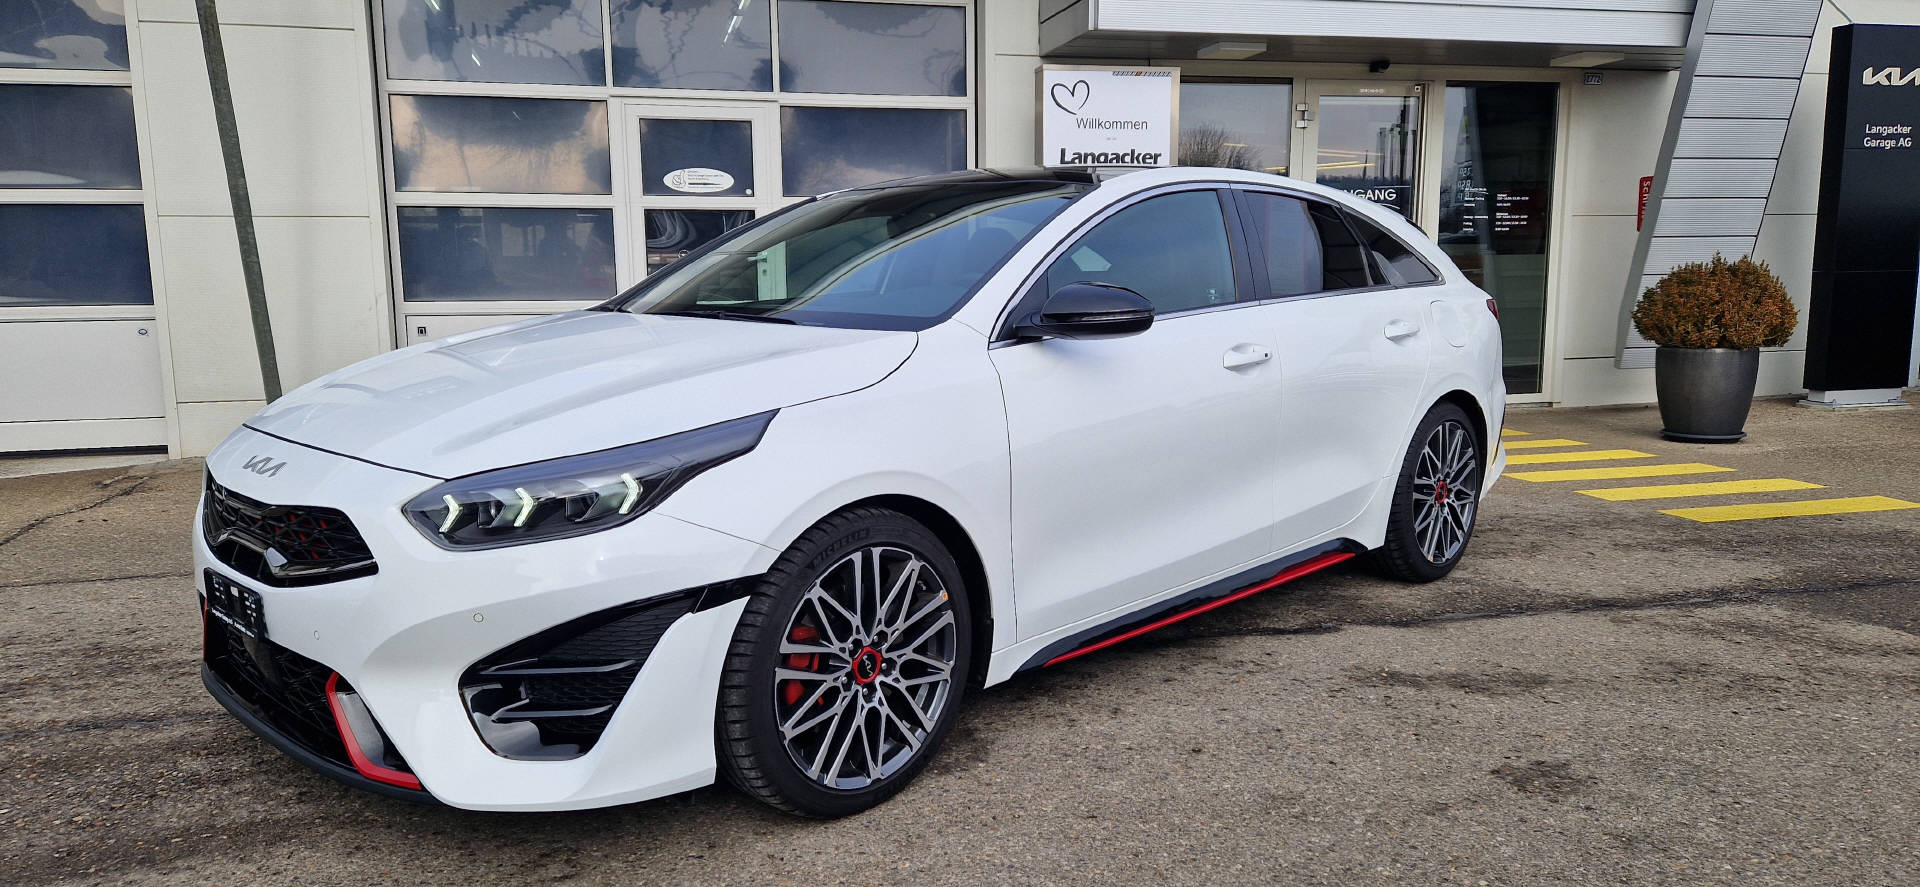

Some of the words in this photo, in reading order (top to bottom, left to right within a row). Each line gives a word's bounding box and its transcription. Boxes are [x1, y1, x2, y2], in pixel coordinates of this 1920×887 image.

[1076, 117, 1148, 130] Willkommen
[1865, 123, 1912, 136] Langacker
[1863, 137, 1897, 149] Garage
[1897, 137, 1912, 147] AG
[1059, 147, 1162, 165] Langacker
